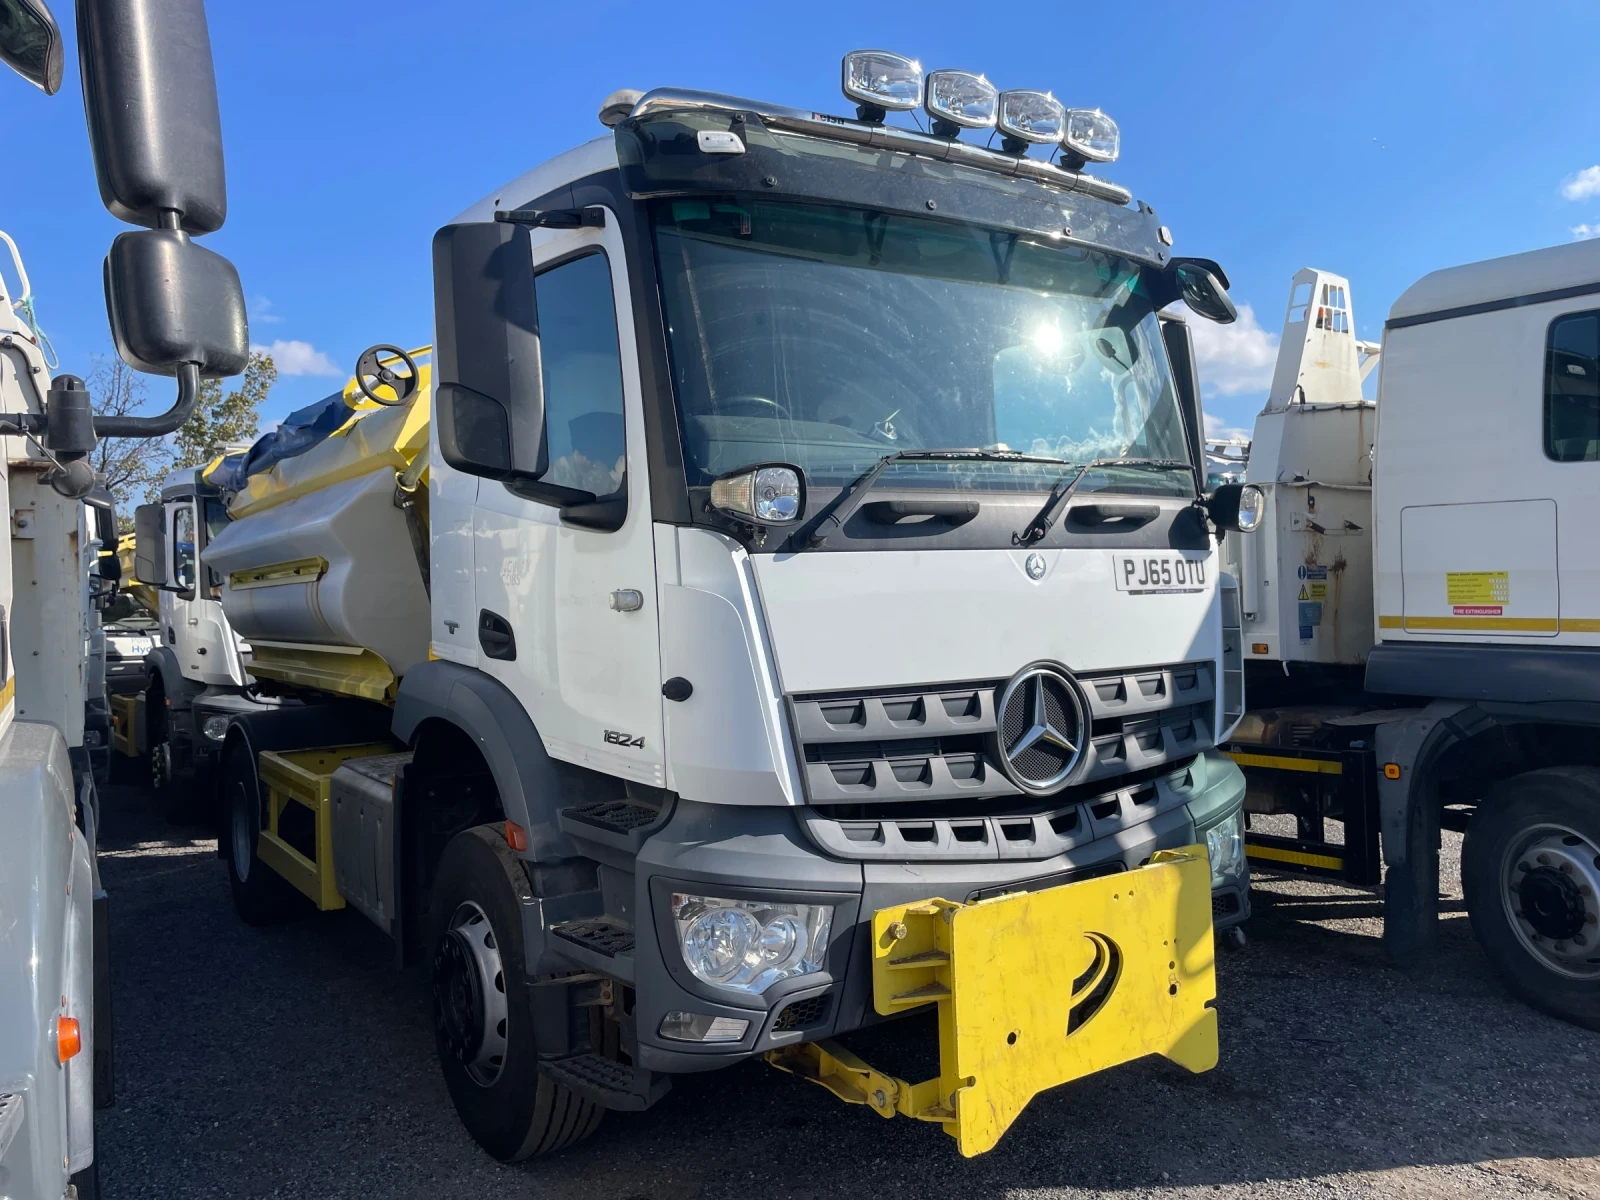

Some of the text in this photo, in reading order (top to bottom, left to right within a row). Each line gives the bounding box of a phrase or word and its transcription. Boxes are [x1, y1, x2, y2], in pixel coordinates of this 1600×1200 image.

[1123, 559, 1206, 585] PJ65 OTU
[603, 729, 646, 750] 1824
